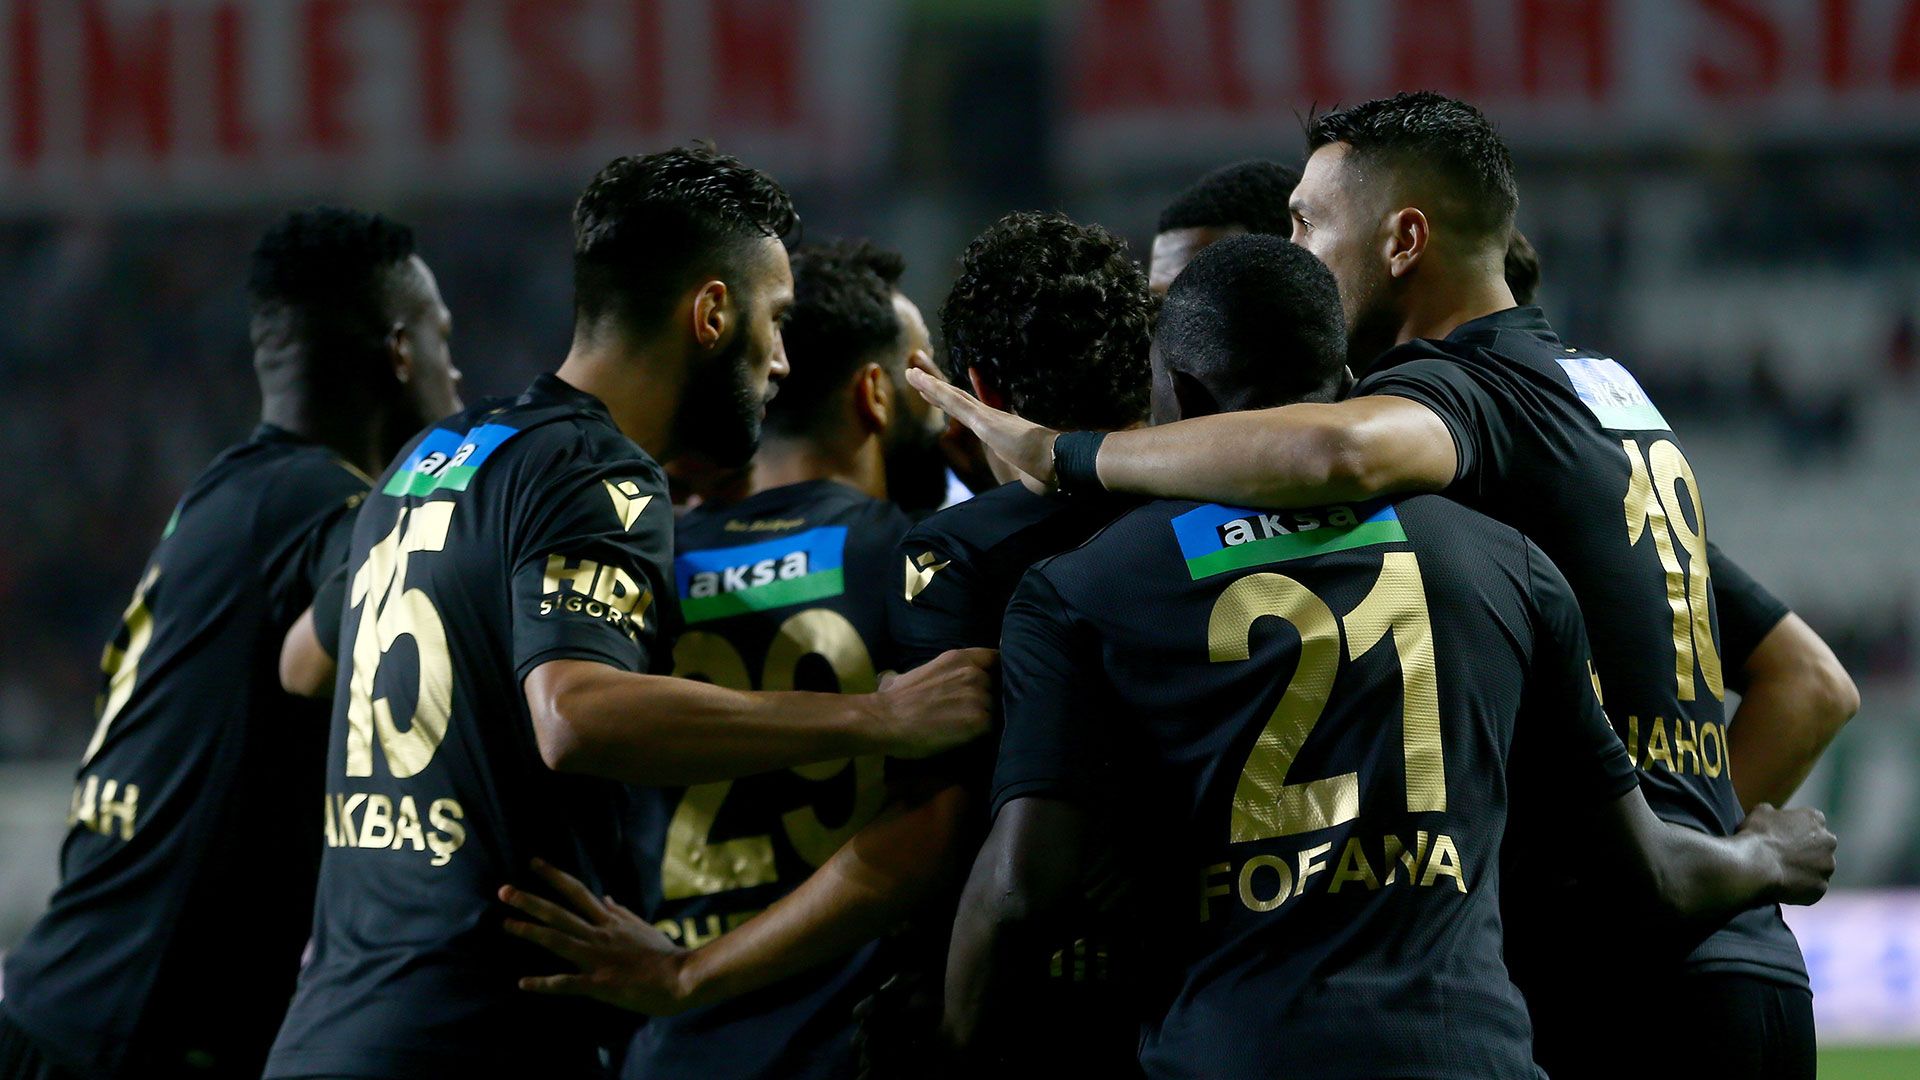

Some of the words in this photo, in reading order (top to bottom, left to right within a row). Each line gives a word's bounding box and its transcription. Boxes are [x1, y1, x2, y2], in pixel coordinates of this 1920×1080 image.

[345, 500, 456, 779] 15
[690, 551, 808, 598] aksa
[1223, 505, 1360, 547] aksa
[1623, 439, 1725, 702] 18
[661, 608, 886, 900] 29
[1208, 552, 1447, 844] 21
[1199, 830, 1468, 922] FOFANA
